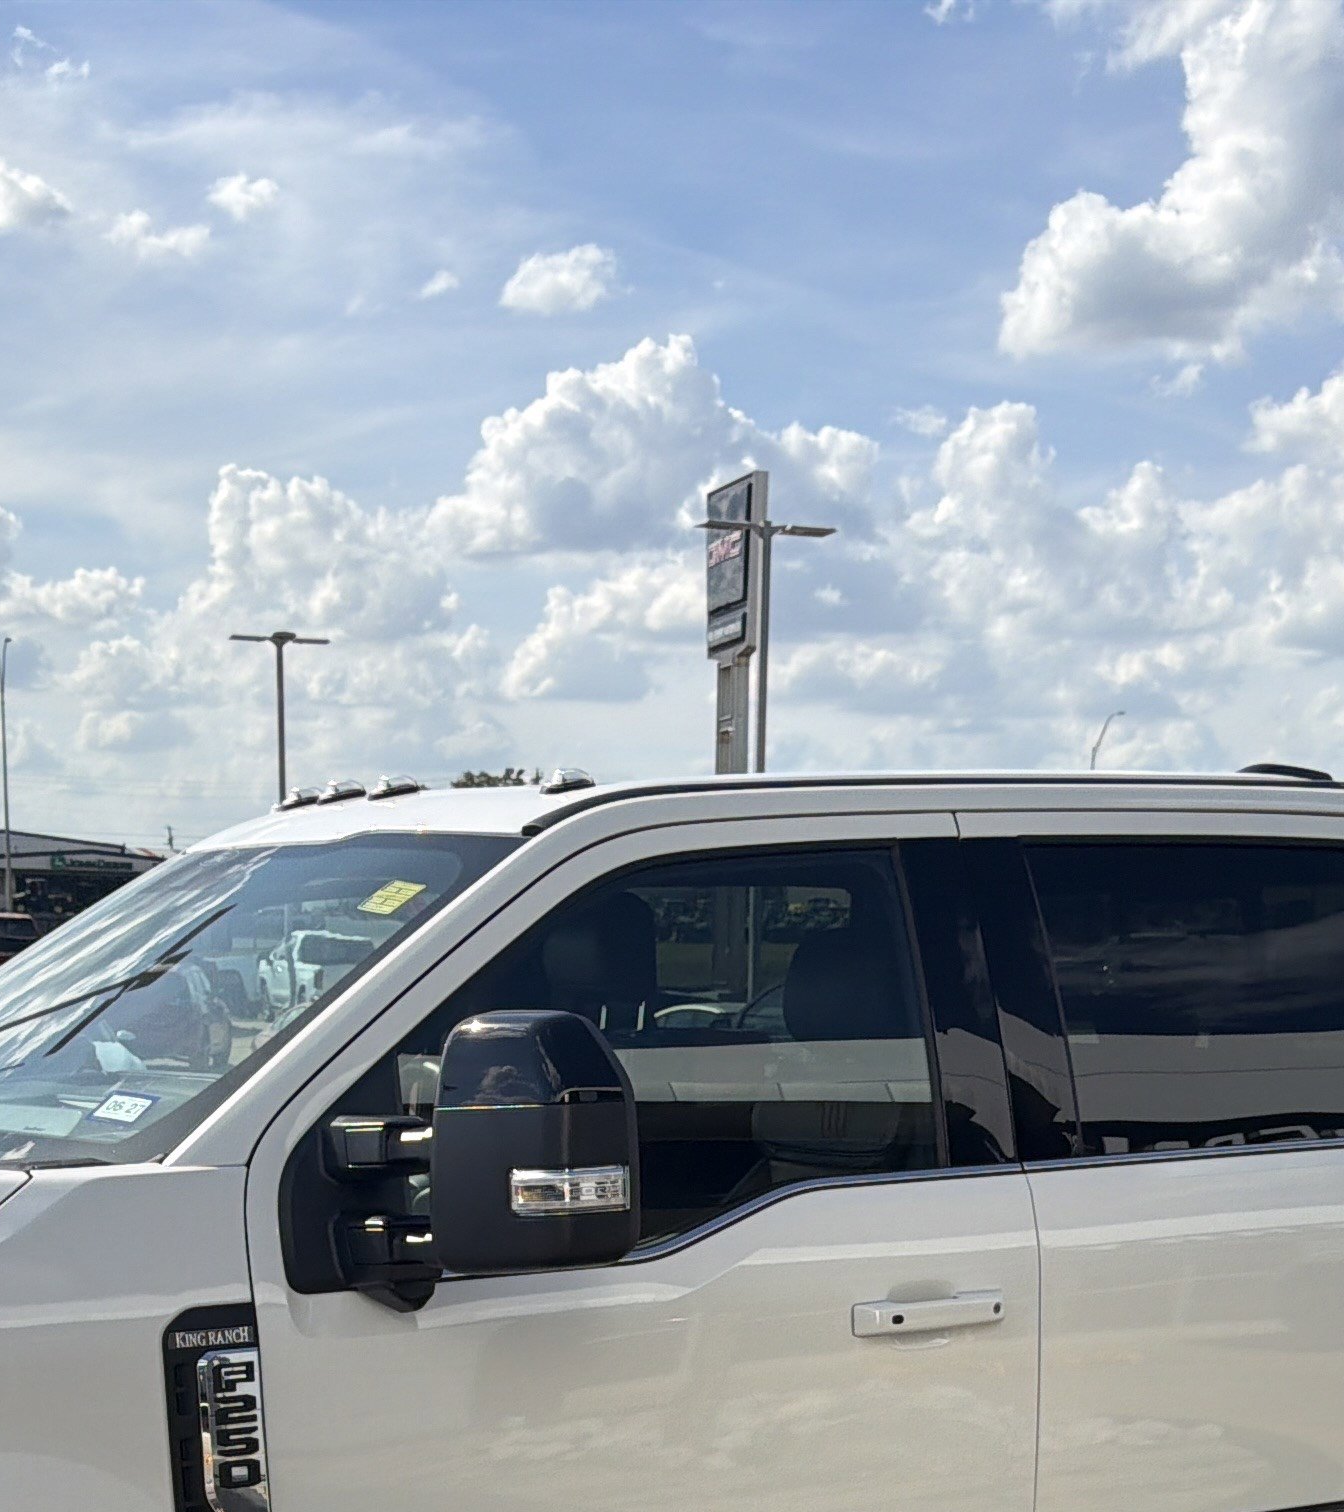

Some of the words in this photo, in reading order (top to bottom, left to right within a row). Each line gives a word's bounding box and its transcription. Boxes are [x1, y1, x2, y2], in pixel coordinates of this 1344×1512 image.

[708, 530, 742, 567] GMC
[175, 1331, 206, 1349] KING
[208, 1326, 249, 1346] RANCH
[212, 1360, 262, 1489] F250
